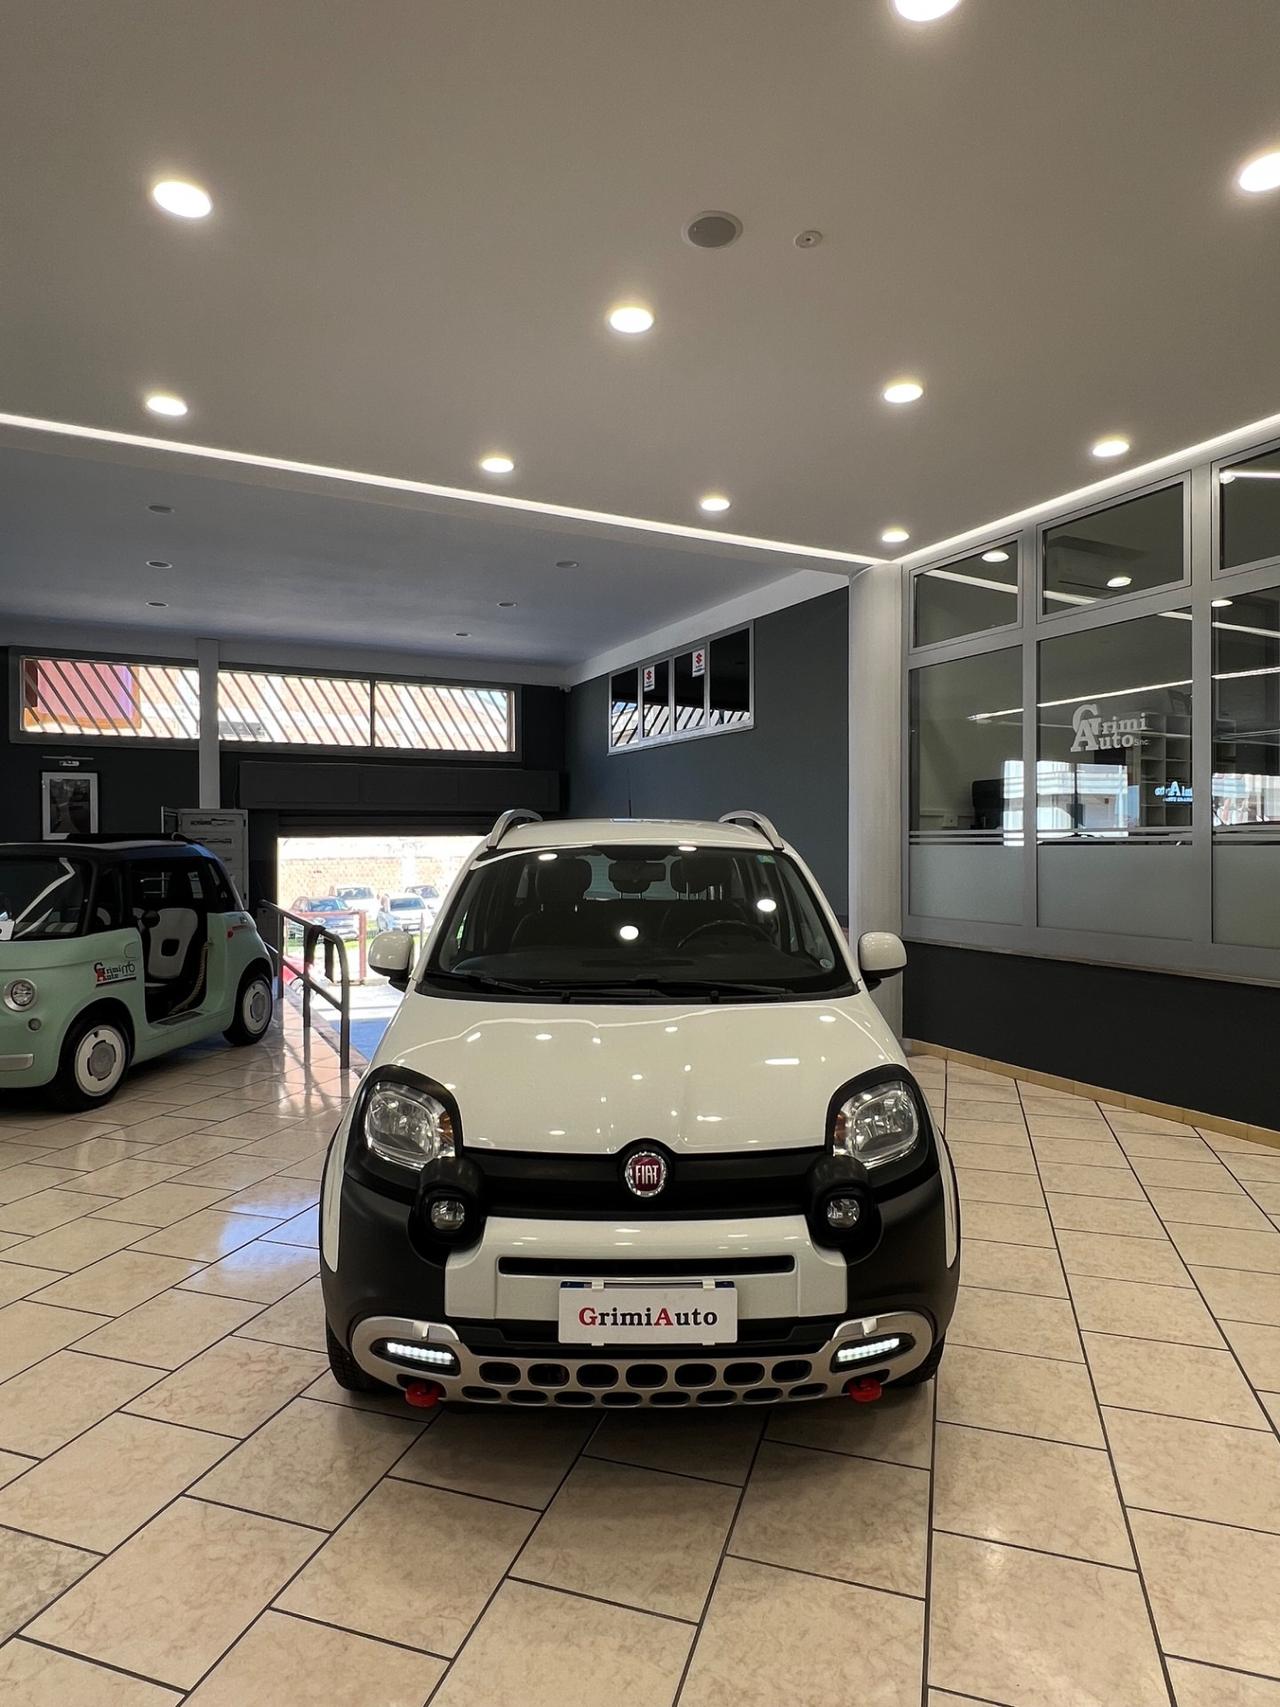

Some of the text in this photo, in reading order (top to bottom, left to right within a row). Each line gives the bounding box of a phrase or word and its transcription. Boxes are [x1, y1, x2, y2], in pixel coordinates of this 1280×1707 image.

[1072, 704, 1148, 735] Grimi
[1070, 718, 1134, 752] Auto
[635, 1165, 659, 1185] FIAT
[578, 1307, 718, 1327] GrimiAuto
